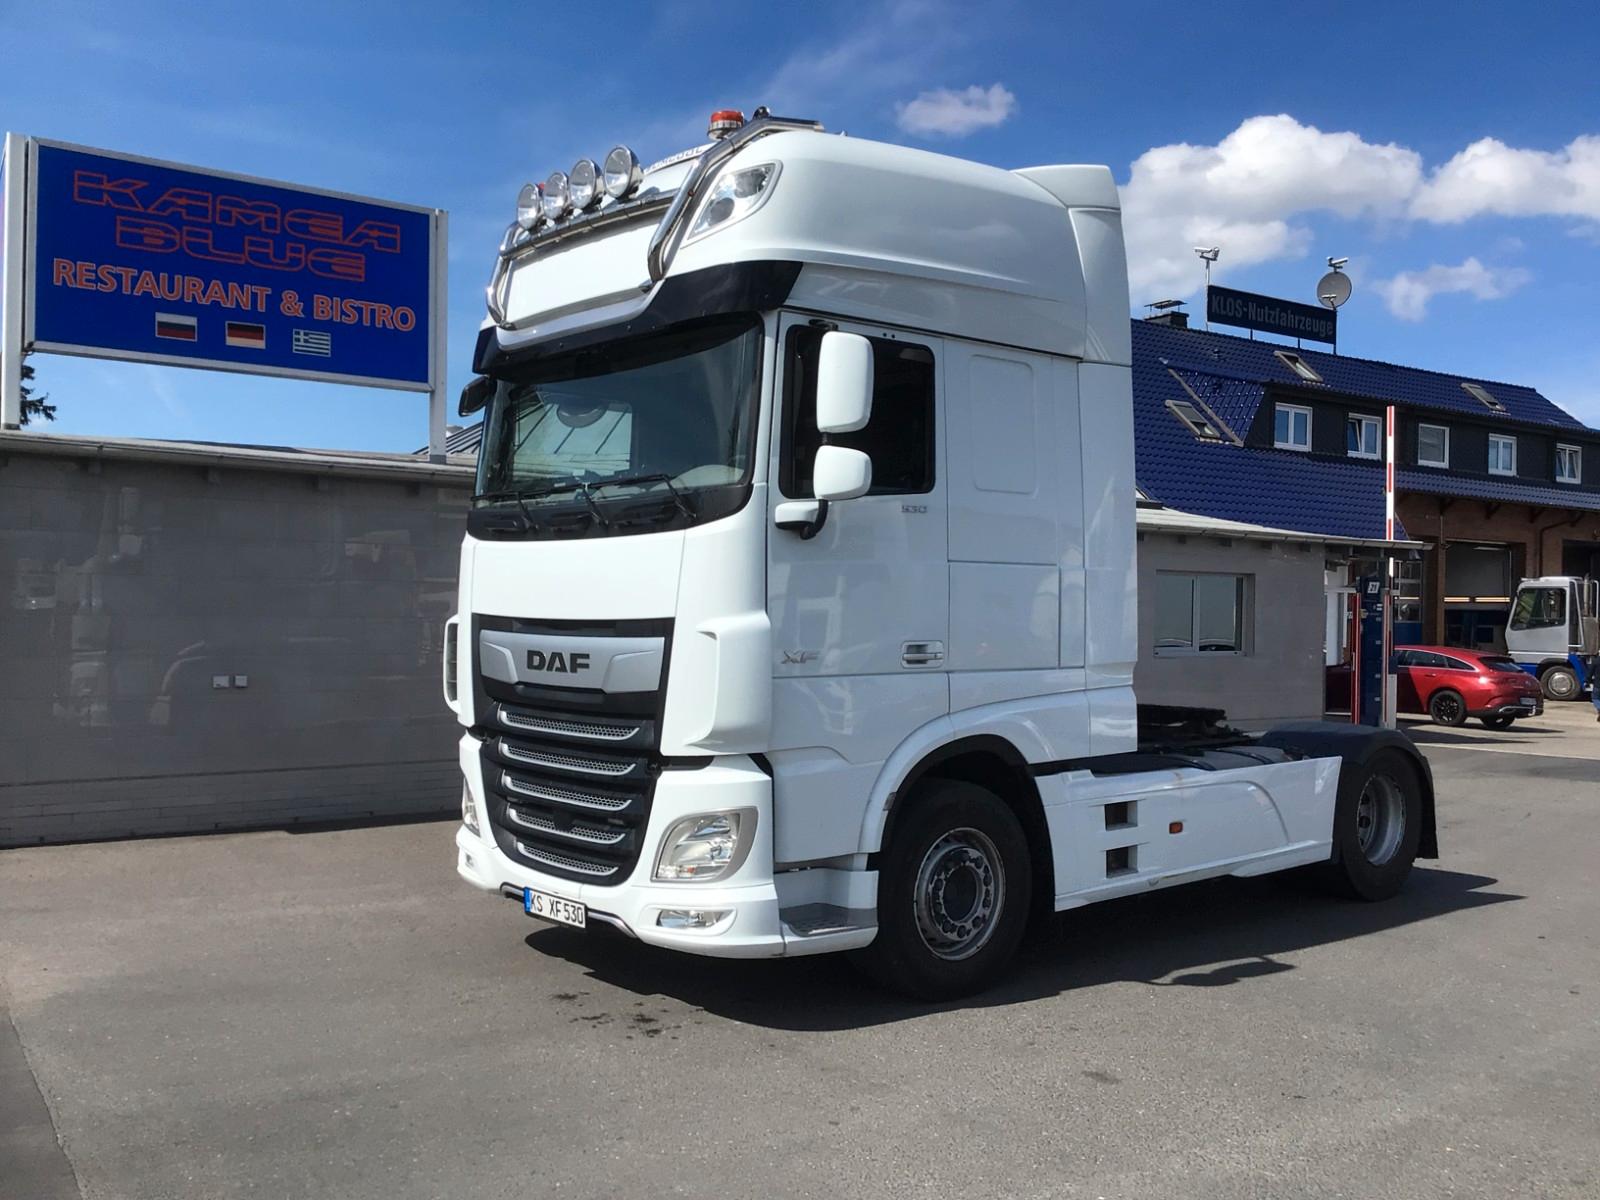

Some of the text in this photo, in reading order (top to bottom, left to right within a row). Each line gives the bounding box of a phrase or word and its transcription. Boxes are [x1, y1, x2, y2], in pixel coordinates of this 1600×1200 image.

[116, 215, 365, 281] BLUE
[53, 258, 416, 331] RESTAURANT & BISTRO
[1211, 294, 1334, 337] KLOS-Nutzfahrzeuge
[527, 650, 590, 673] DAF
[530, 893, 543, 912] KS
